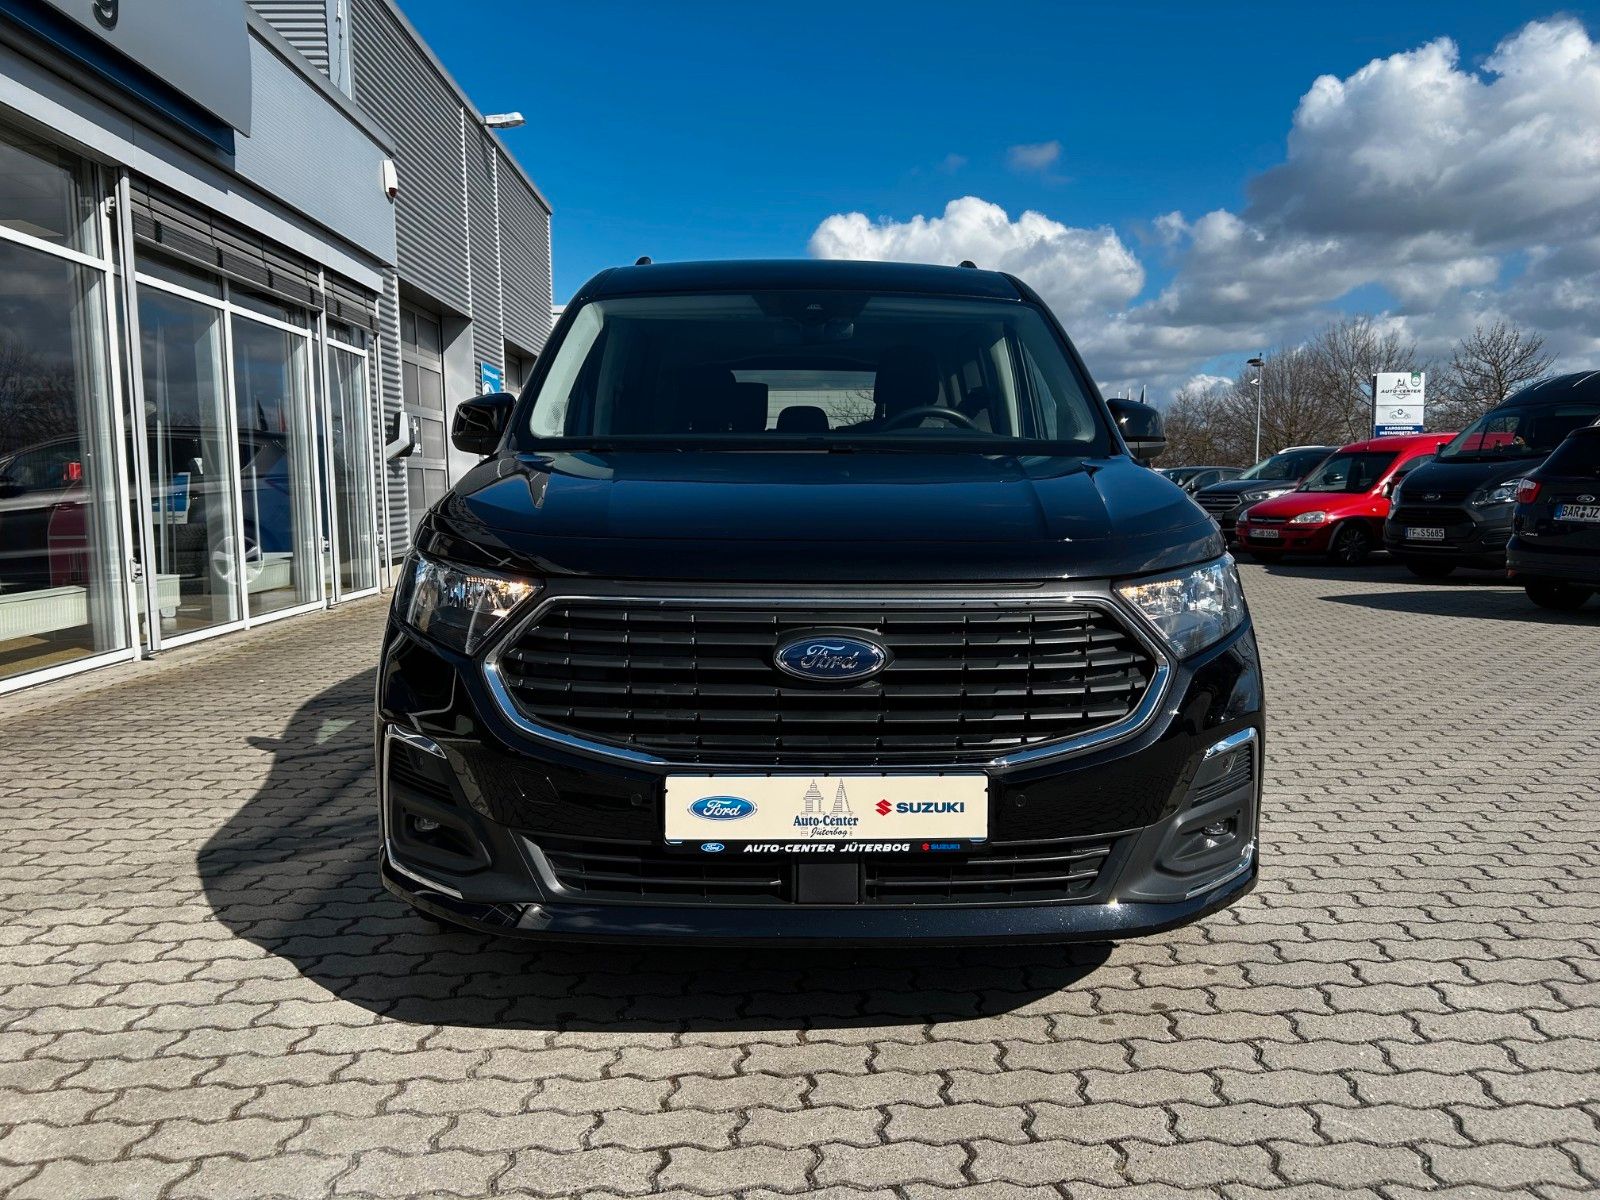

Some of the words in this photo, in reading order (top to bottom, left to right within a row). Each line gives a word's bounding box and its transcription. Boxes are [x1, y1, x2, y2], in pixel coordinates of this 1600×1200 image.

[1561, 505, 1580, 517] BAR
[800, 644, 860, 669] Ford
[702, 799, 742, 816] Ford
[896, 802, 965, 813] SUZUKI
[793, 815, 859, 827] Auto-Center
[810, 827, 848, 838] Jüterbog
[743, 844, 836, 853] AUTO-CENTER
[839, 842, 911, 853] JÜTERBOG
